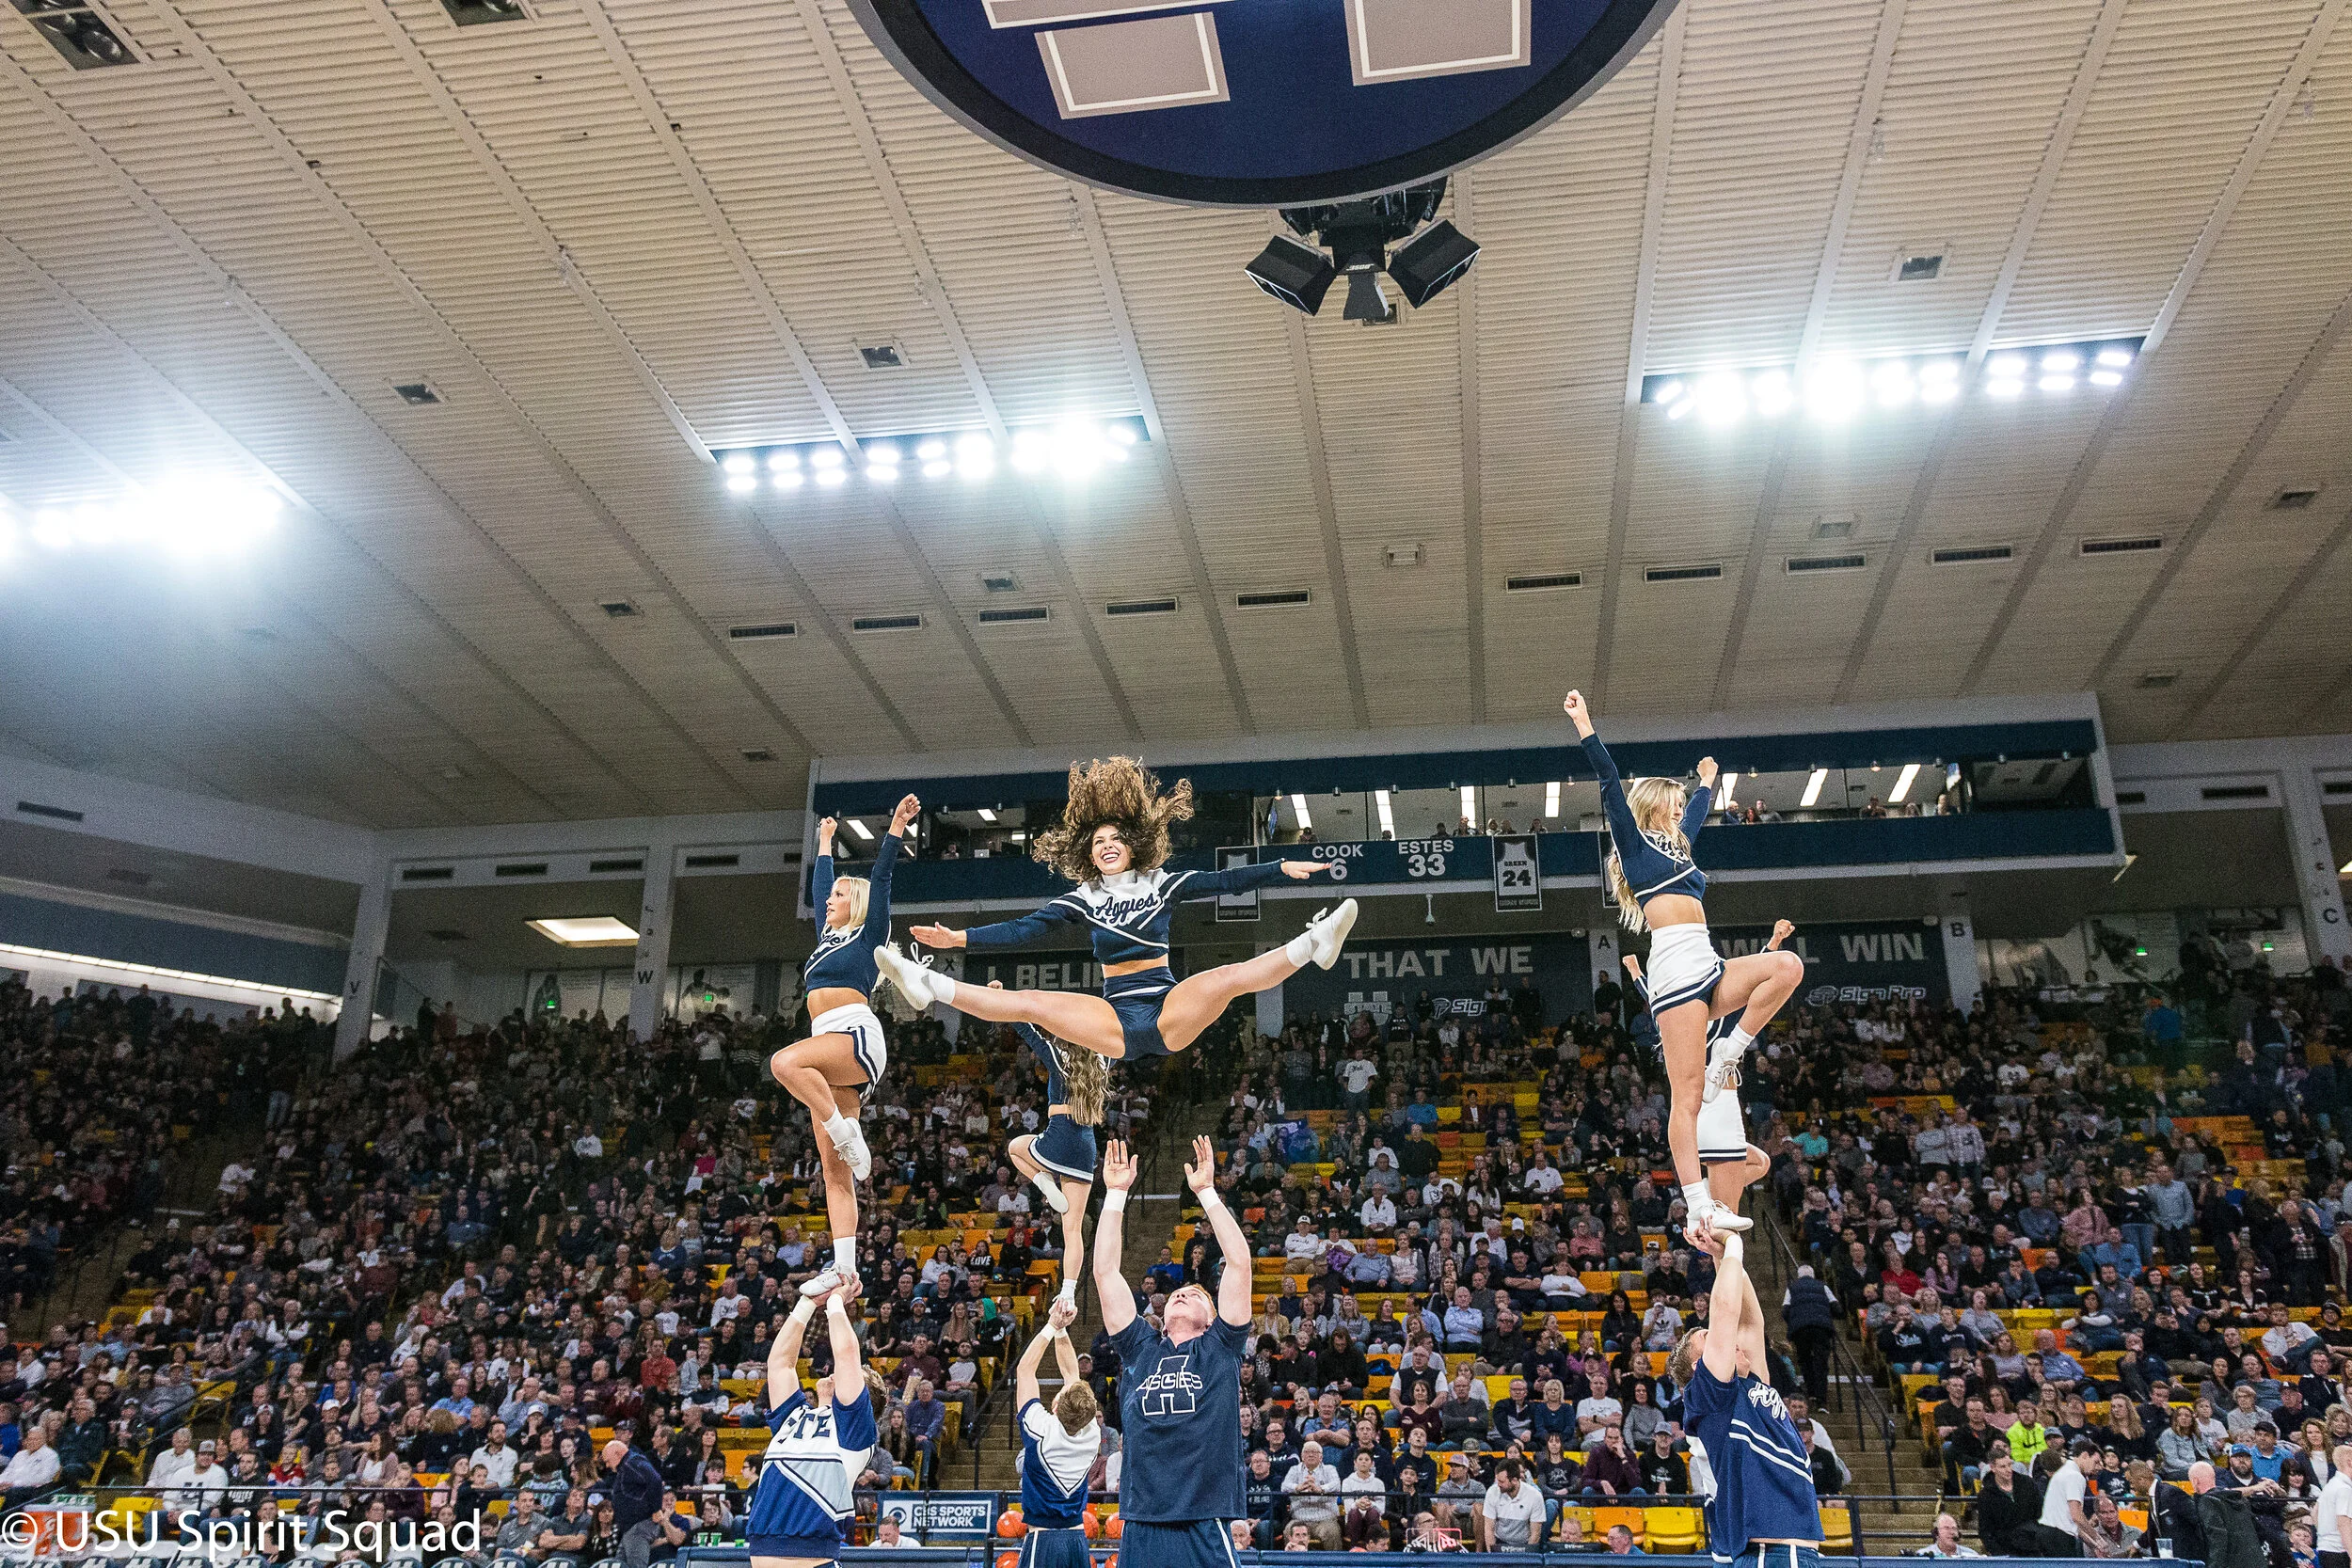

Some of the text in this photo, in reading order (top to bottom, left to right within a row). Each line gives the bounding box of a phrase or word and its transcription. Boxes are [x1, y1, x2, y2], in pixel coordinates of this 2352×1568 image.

[1312, 844, 1363, 859] COOK
[1398, 839, 1454, 855] ESTES
[1329, 858, 1348, 880] 6
[1408, 854, 1446, 877] 33
[1502, 870, 1532, 887] 24
[1094, 893, 1160, 925] Aggies
[2323, 908, 2339, 924] C
[1951, 922, 1965, 937] B
[1598, 935, 1611, 949] A
[1840, 932, 1925, 962] WIN
[944, 958, 956, 972] X
[1343, 946, 1534, 979] THAT WE
[638, 971, 654, 985] W
[1136, 1371, 1203, 1392] AGGIES
[939, 1505, 986, 1517] SPORTS
[913, 1516, 974, 1527] NETWORK
